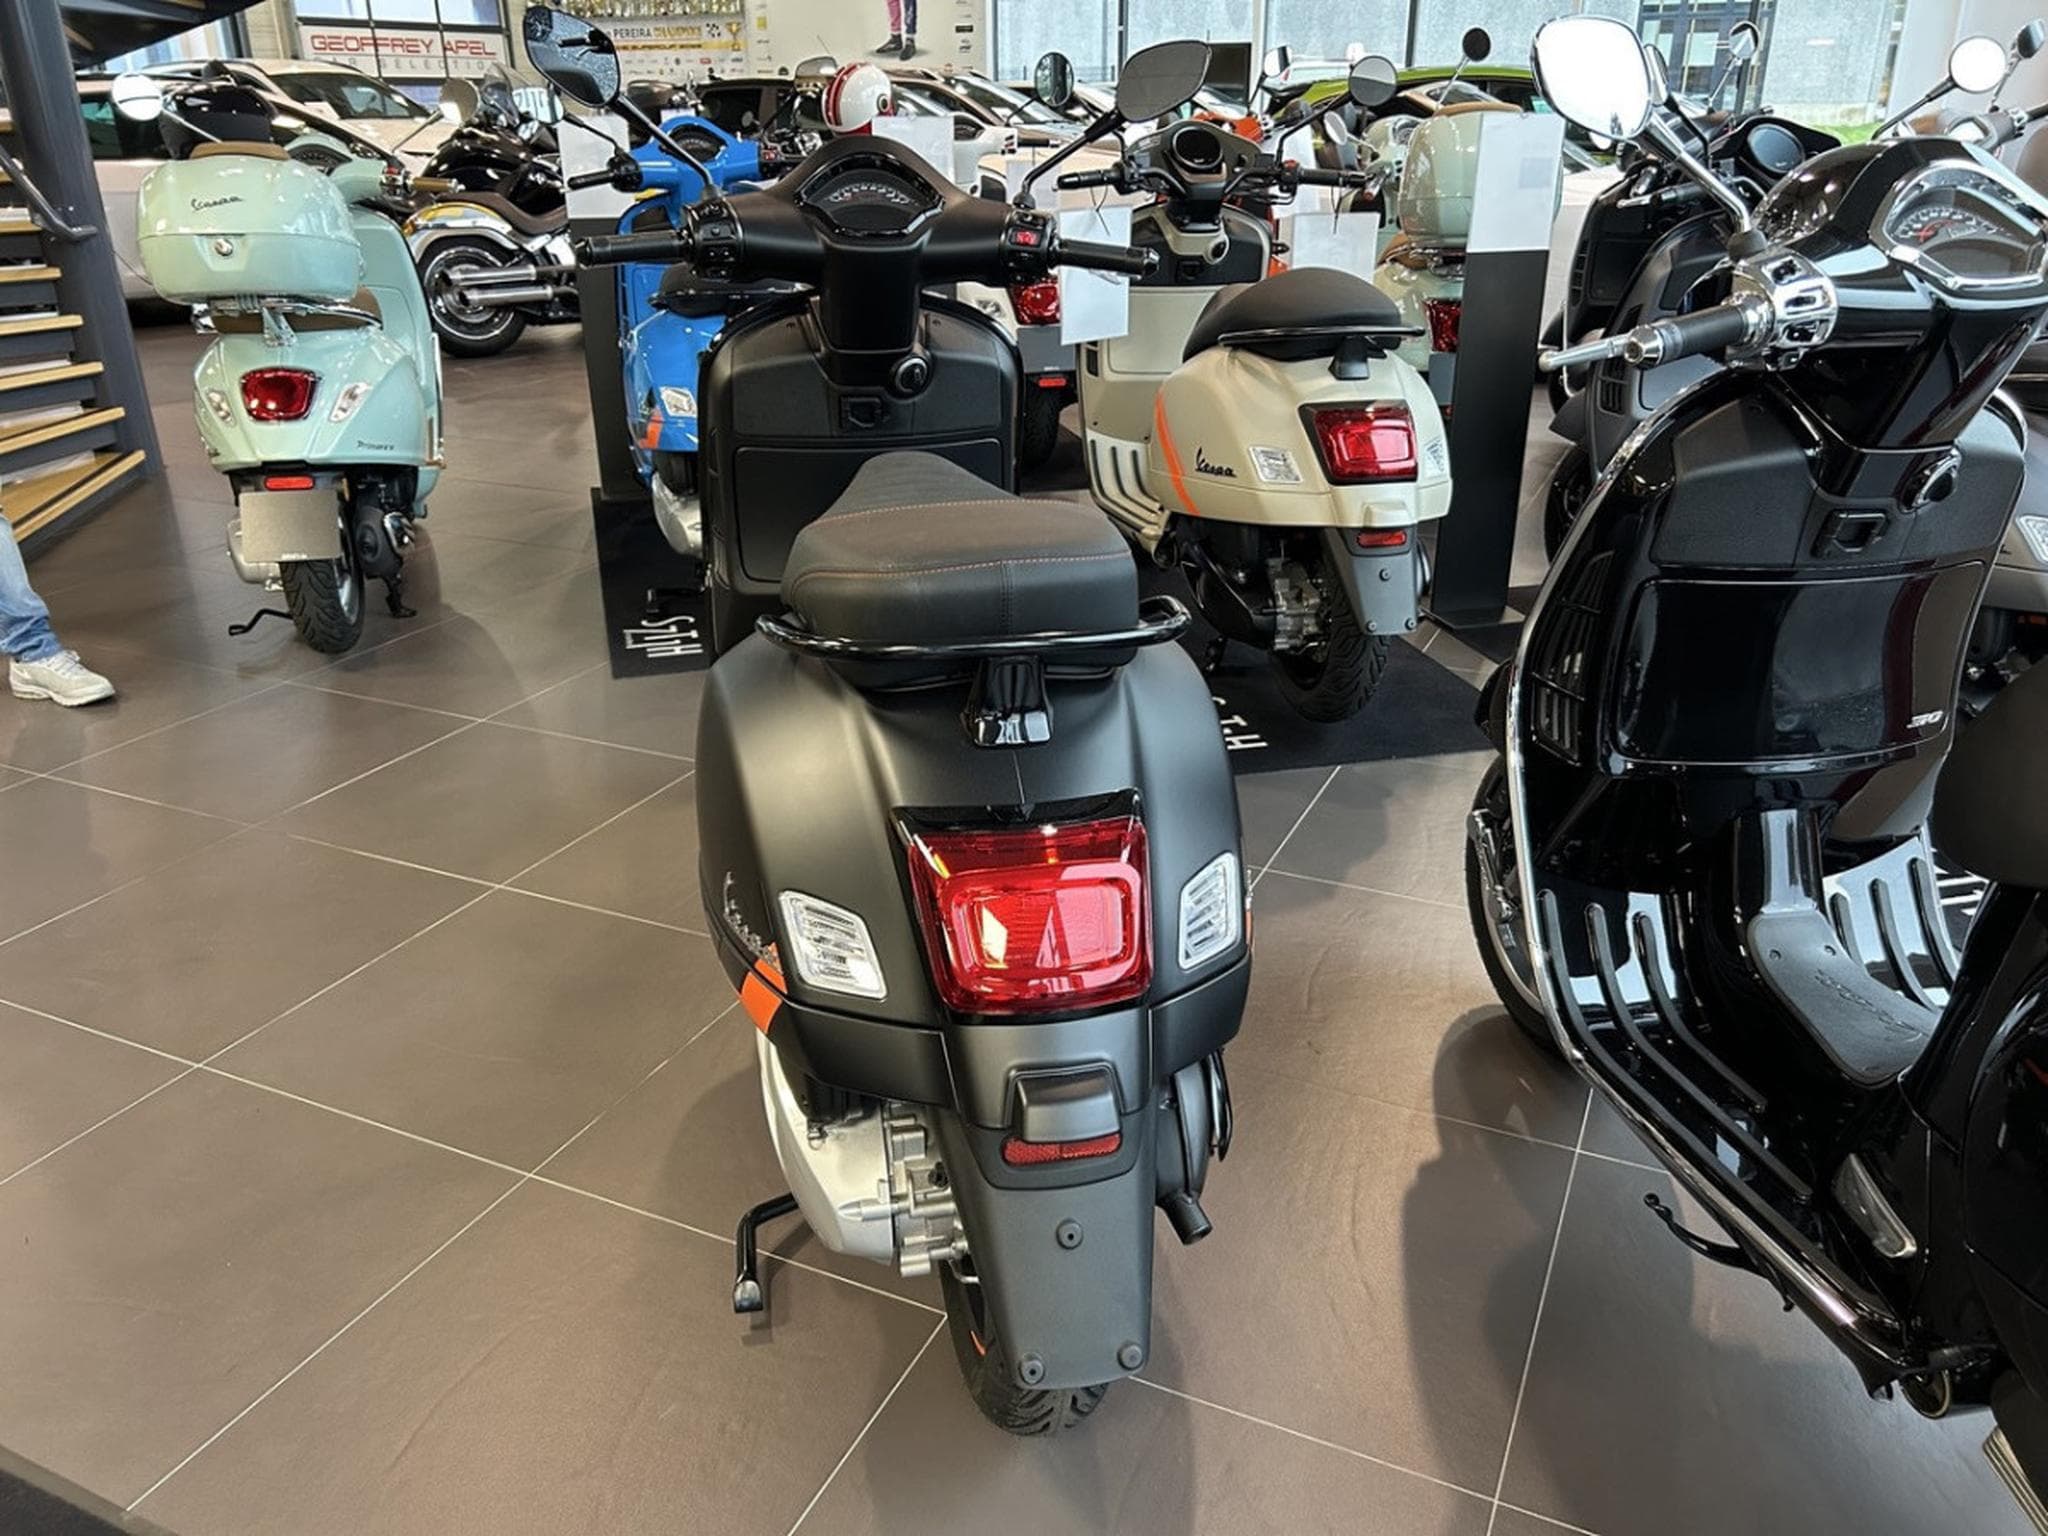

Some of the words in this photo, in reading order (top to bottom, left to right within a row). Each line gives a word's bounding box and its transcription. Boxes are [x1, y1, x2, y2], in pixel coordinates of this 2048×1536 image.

[310, 34, 434, 53] GEOFFREY
[442, 37, 496, 55] APEL
[1195, 447, 1237, 477] Vespa
